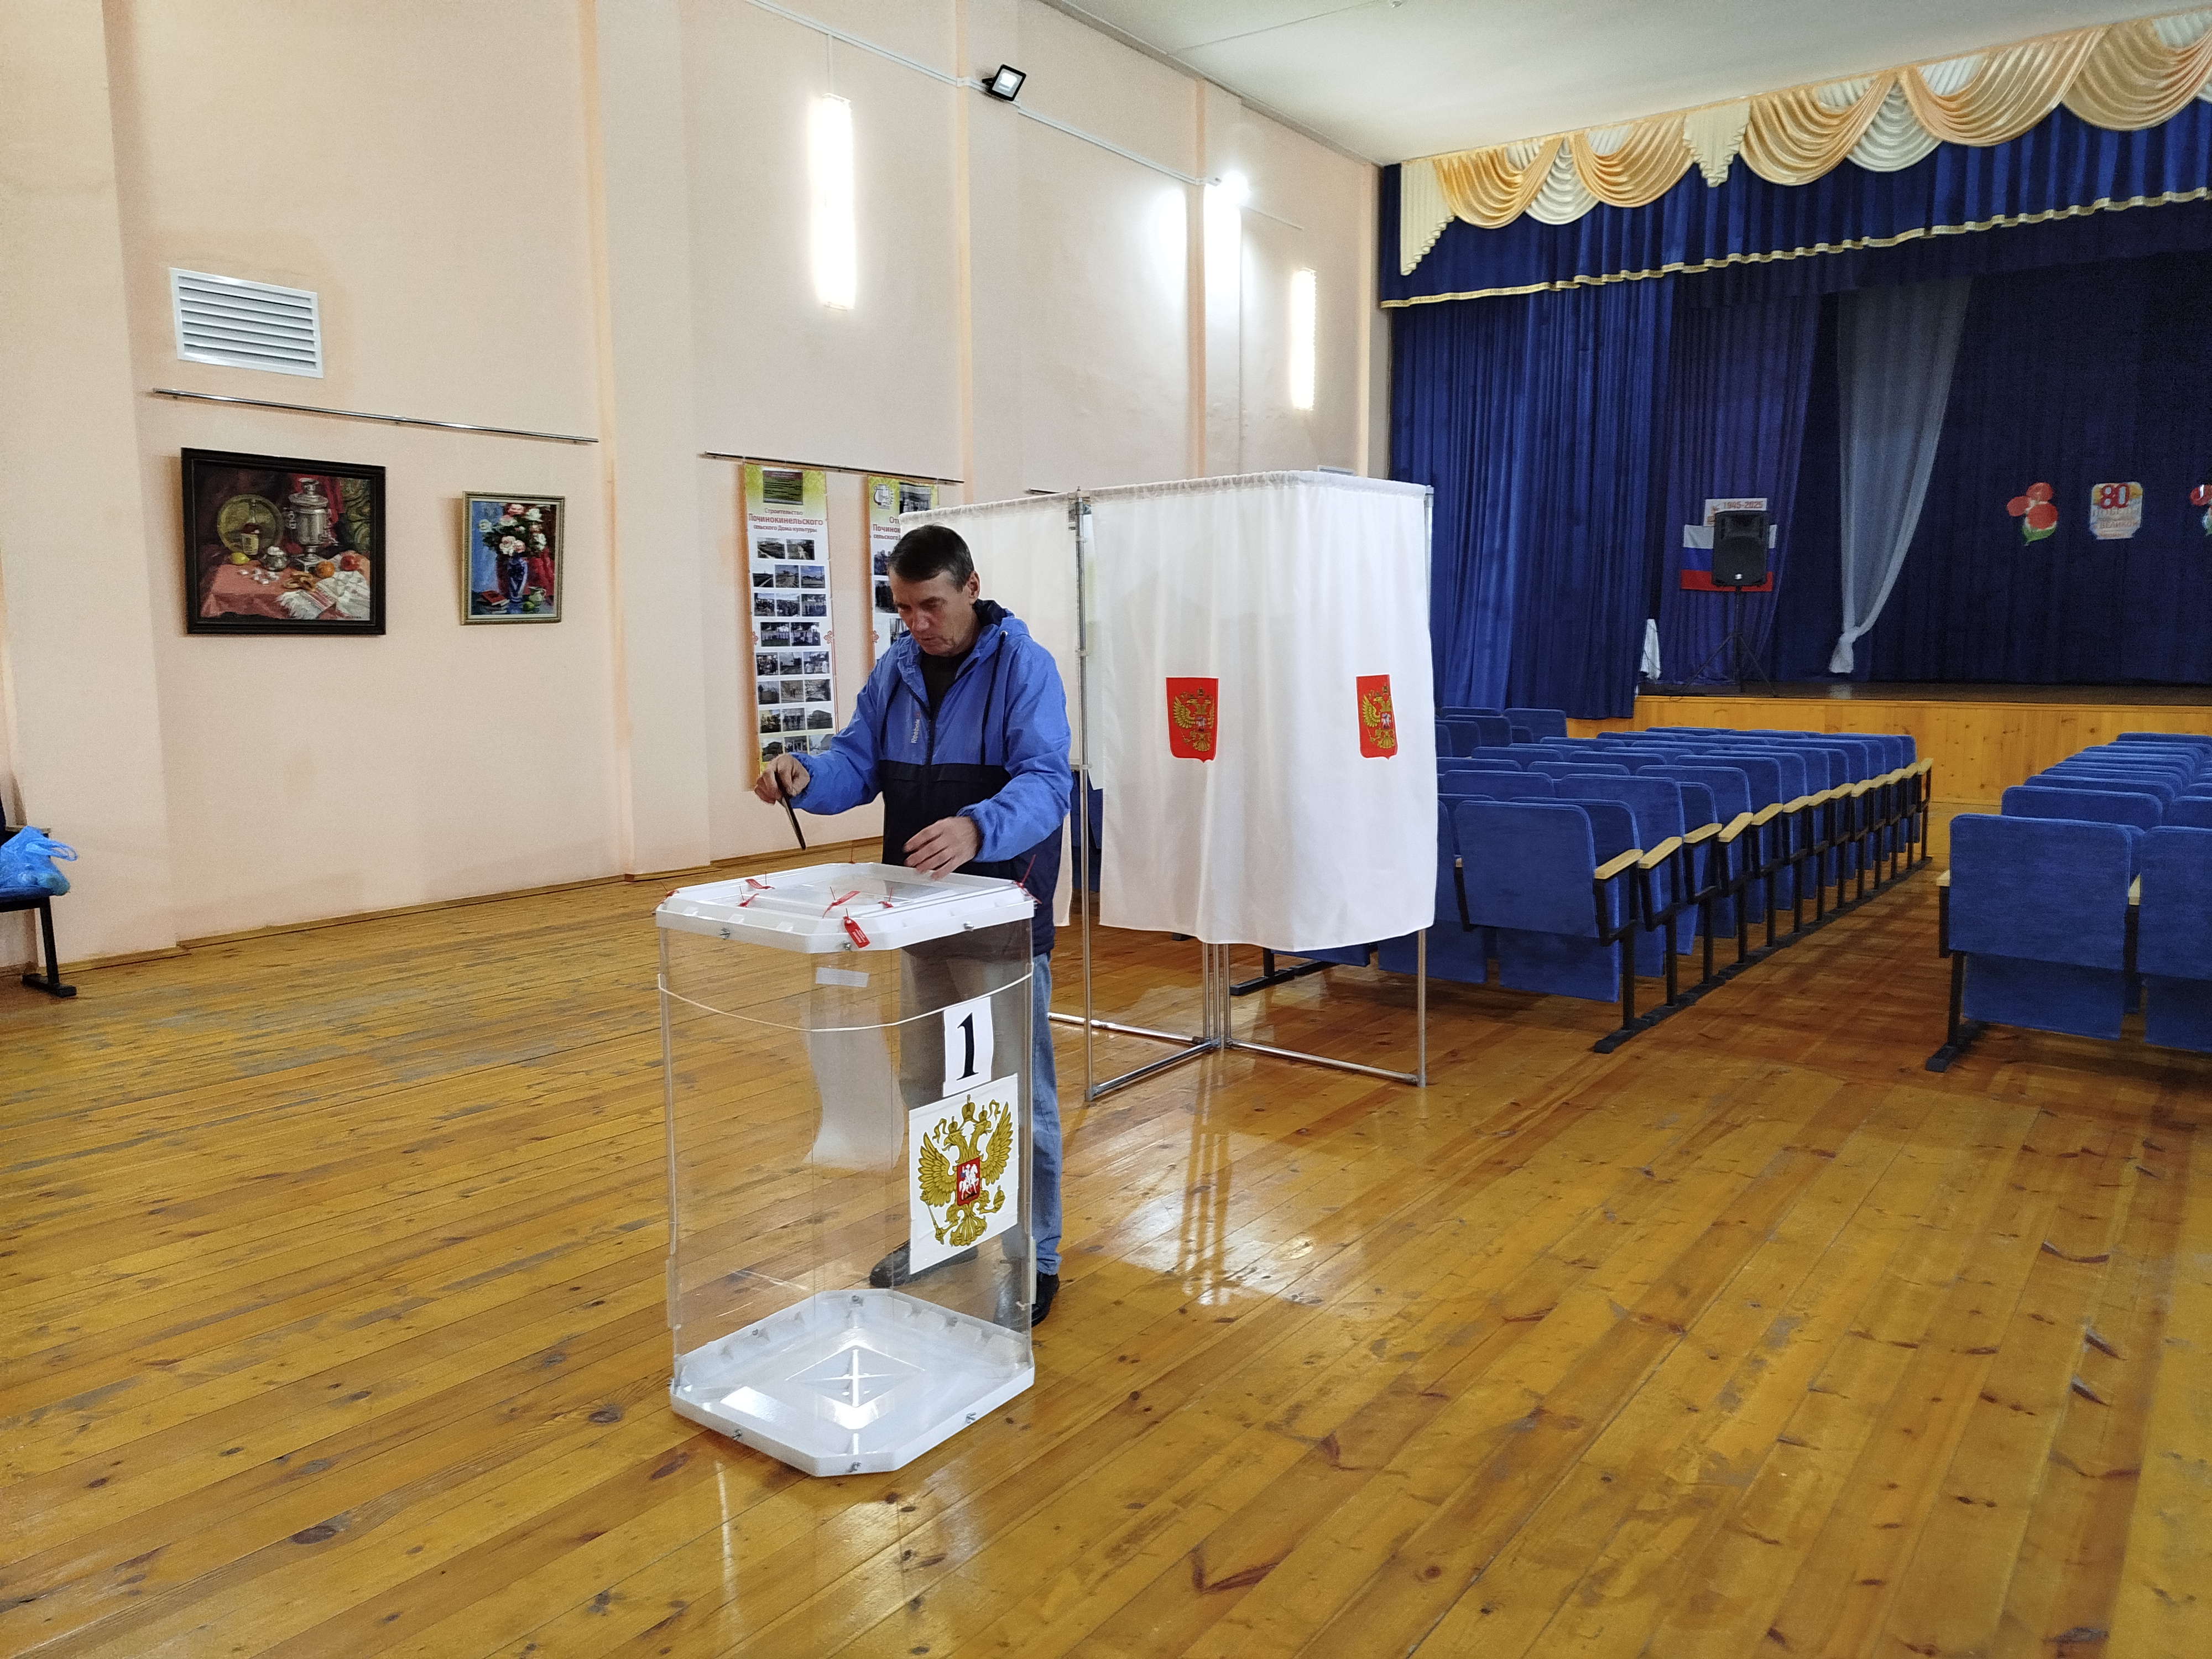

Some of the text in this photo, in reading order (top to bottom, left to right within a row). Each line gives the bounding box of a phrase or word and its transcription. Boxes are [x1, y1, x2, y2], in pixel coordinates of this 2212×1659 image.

[1724, 500, 1764, 509] 1945-2025
[2100, 483, 2130, 509] 80
[748, 513, 823, 525] Починокинельского
[911, 719, 920, 744] Reebok
[956, 1012, 979, 1081] 1
